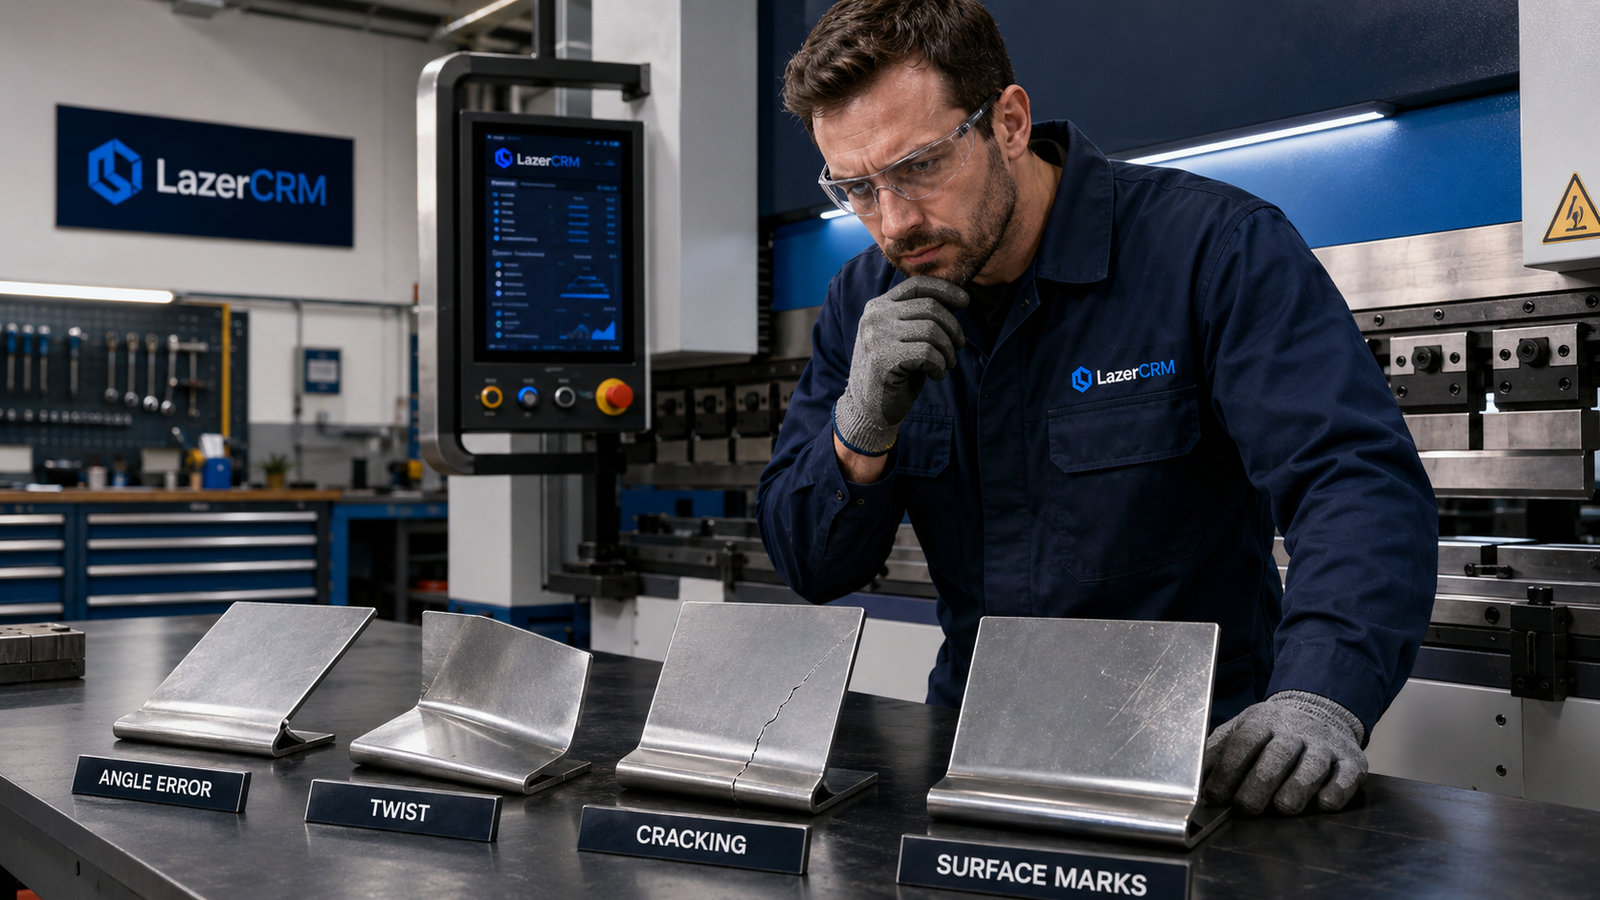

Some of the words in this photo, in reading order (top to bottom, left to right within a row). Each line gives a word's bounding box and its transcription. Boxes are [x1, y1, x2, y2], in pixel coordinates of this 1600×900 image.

[517, 153, 581, 168] LazerCRM
[156, 158, 327, 207] LazerCRM
[1096, 359, 1176, 385] LazerCRM
[98, 769, 153, 793] ANGLE
[156, 775, 213, 798] ERROR
[370, 798, 431, 822] TWIST
[636, 825, 748, 855] CRACKING
[936, 853, 1047, 886] SURFACE
[1054, 867, 1148, 897] MARKS
